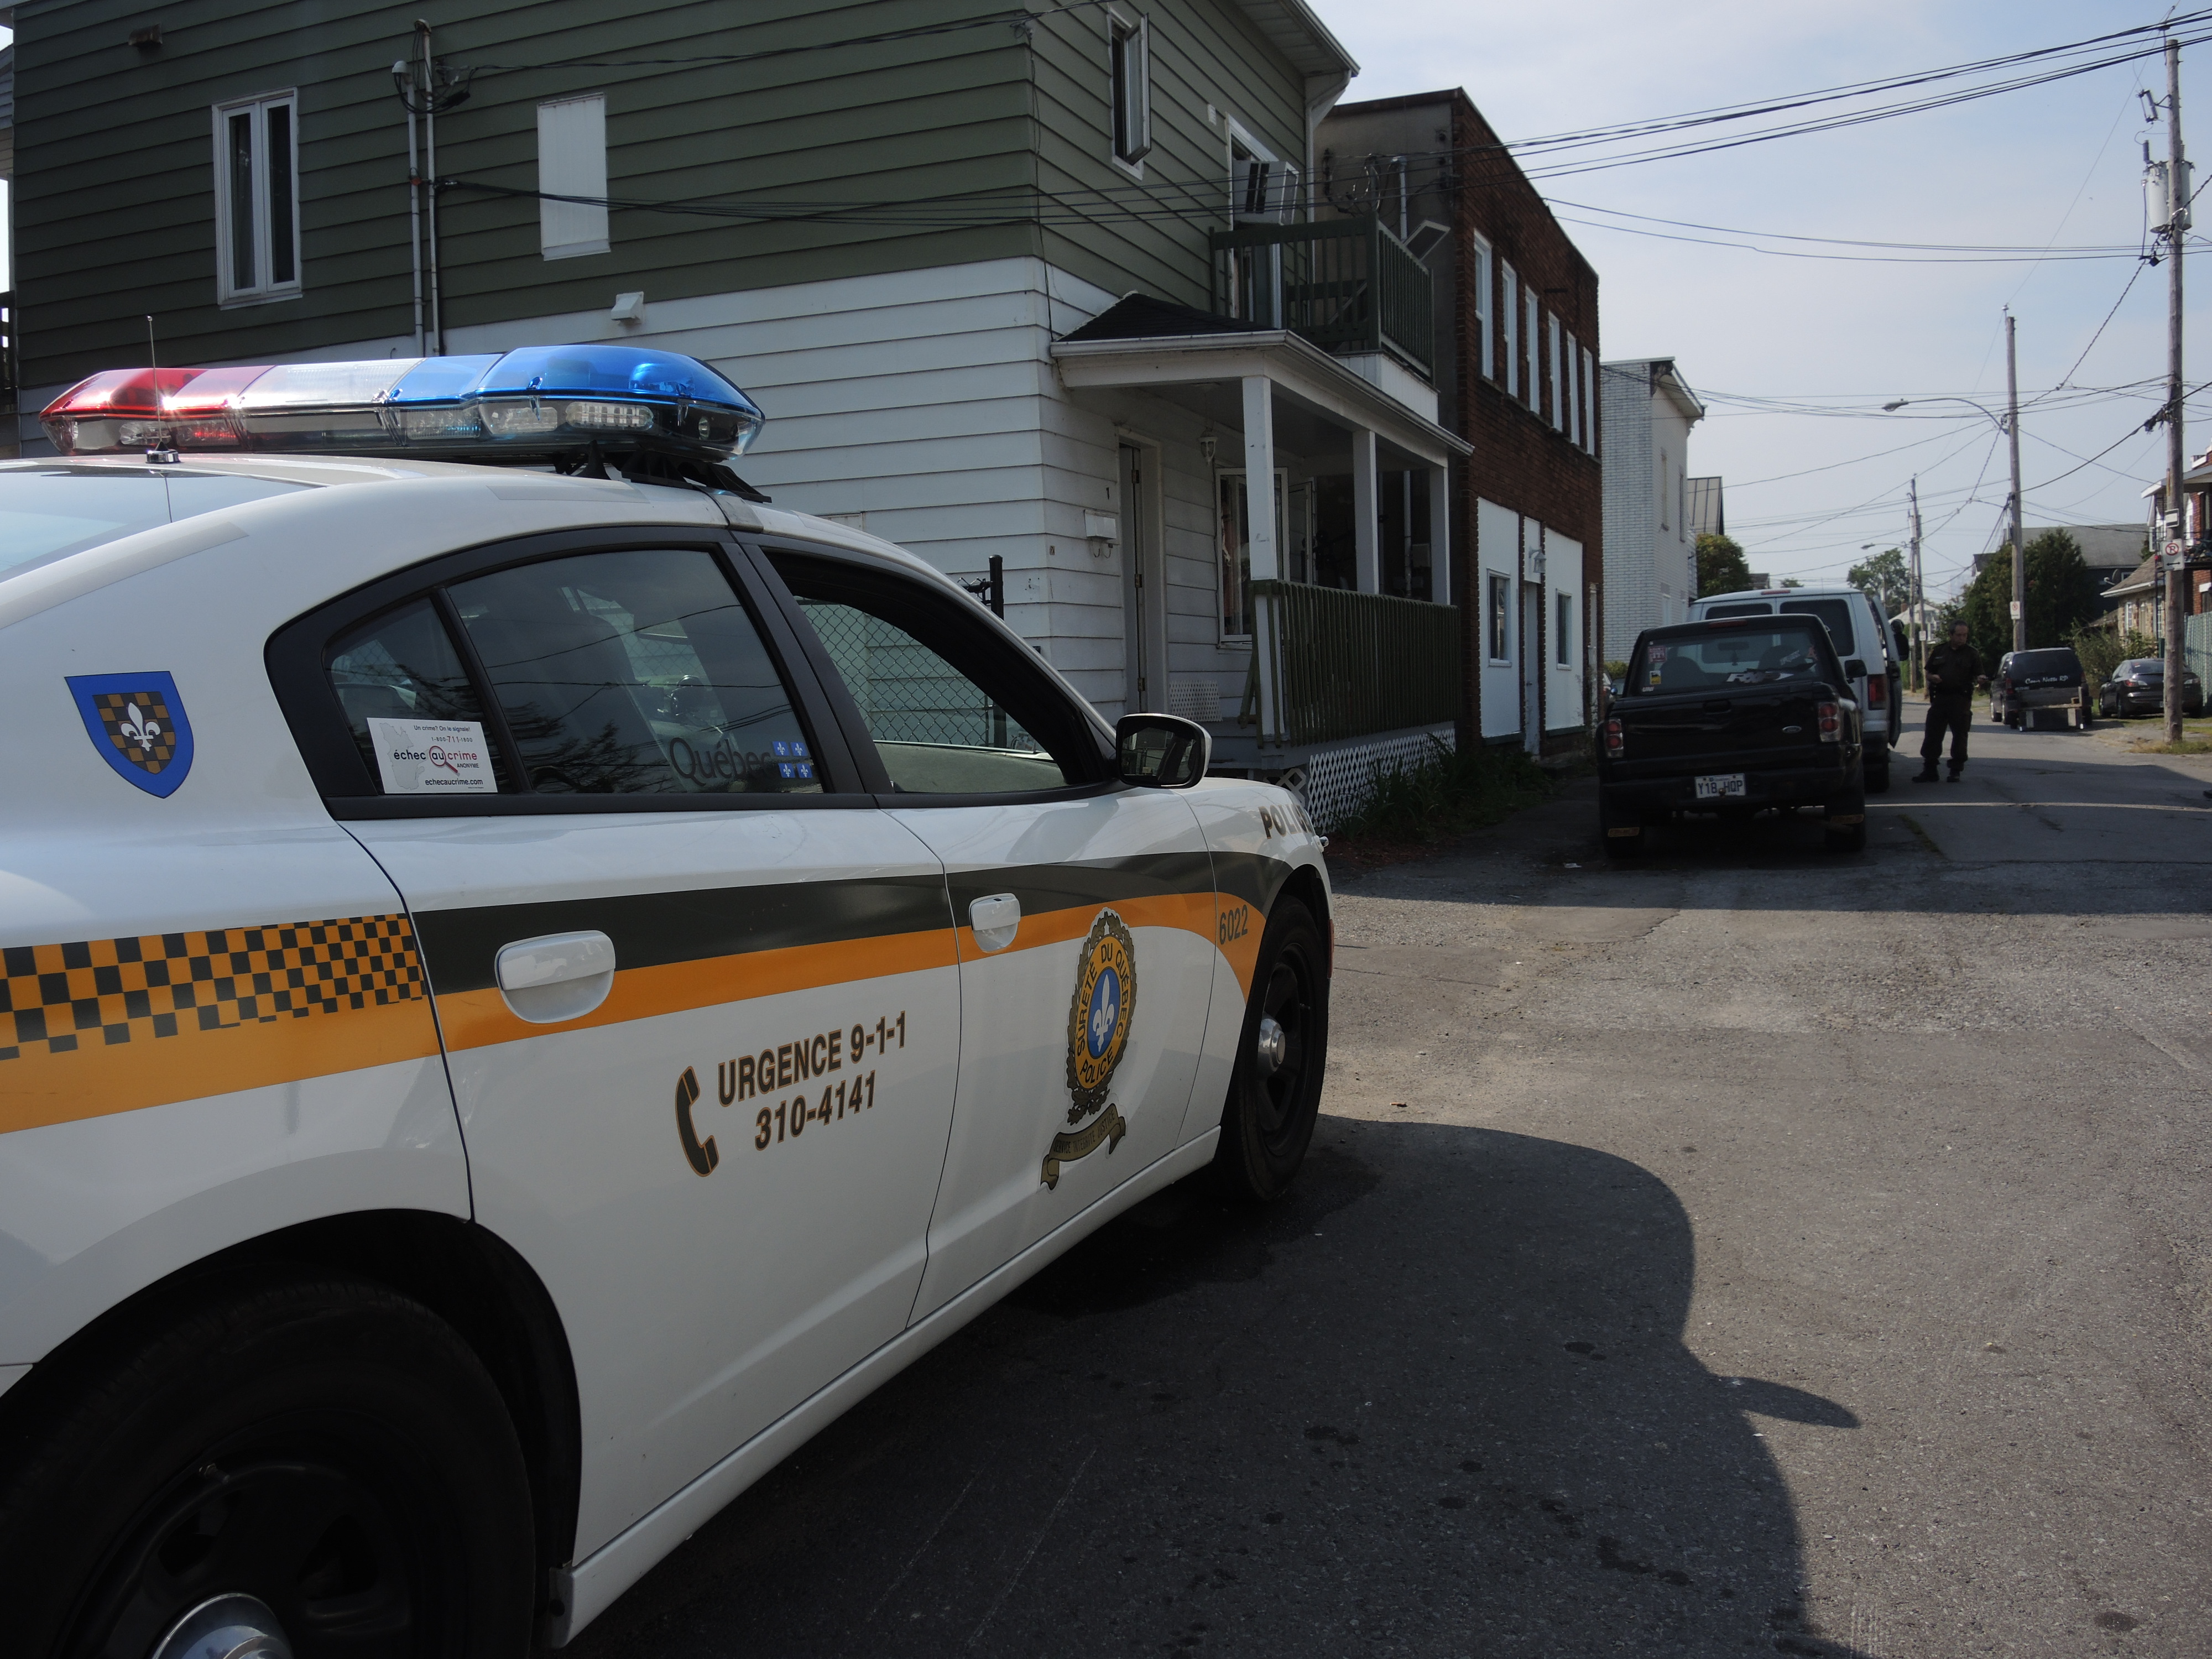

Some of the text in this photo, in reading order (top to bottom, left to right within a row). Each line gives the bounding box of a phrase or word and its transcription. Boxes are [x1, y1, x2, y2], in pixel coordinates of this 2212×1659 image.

[393, 749, 426, 760] échec
[447, 751, 477, 760] crime
[669, 737, 771, 787] Québec
[1219, 904, 1248, 945] 6022
[1076, 943, 1130, 1057] SÛRETÉ DU QUÉBEC
[718, 1010, 906, 1107] URGENCE 9-1-1
[1079, 1046, 1114, 1084] POLICE
[754, 1070, 875, 1151] 310-4141
[1097, 1109, 1115, 1139] JUSTICE
